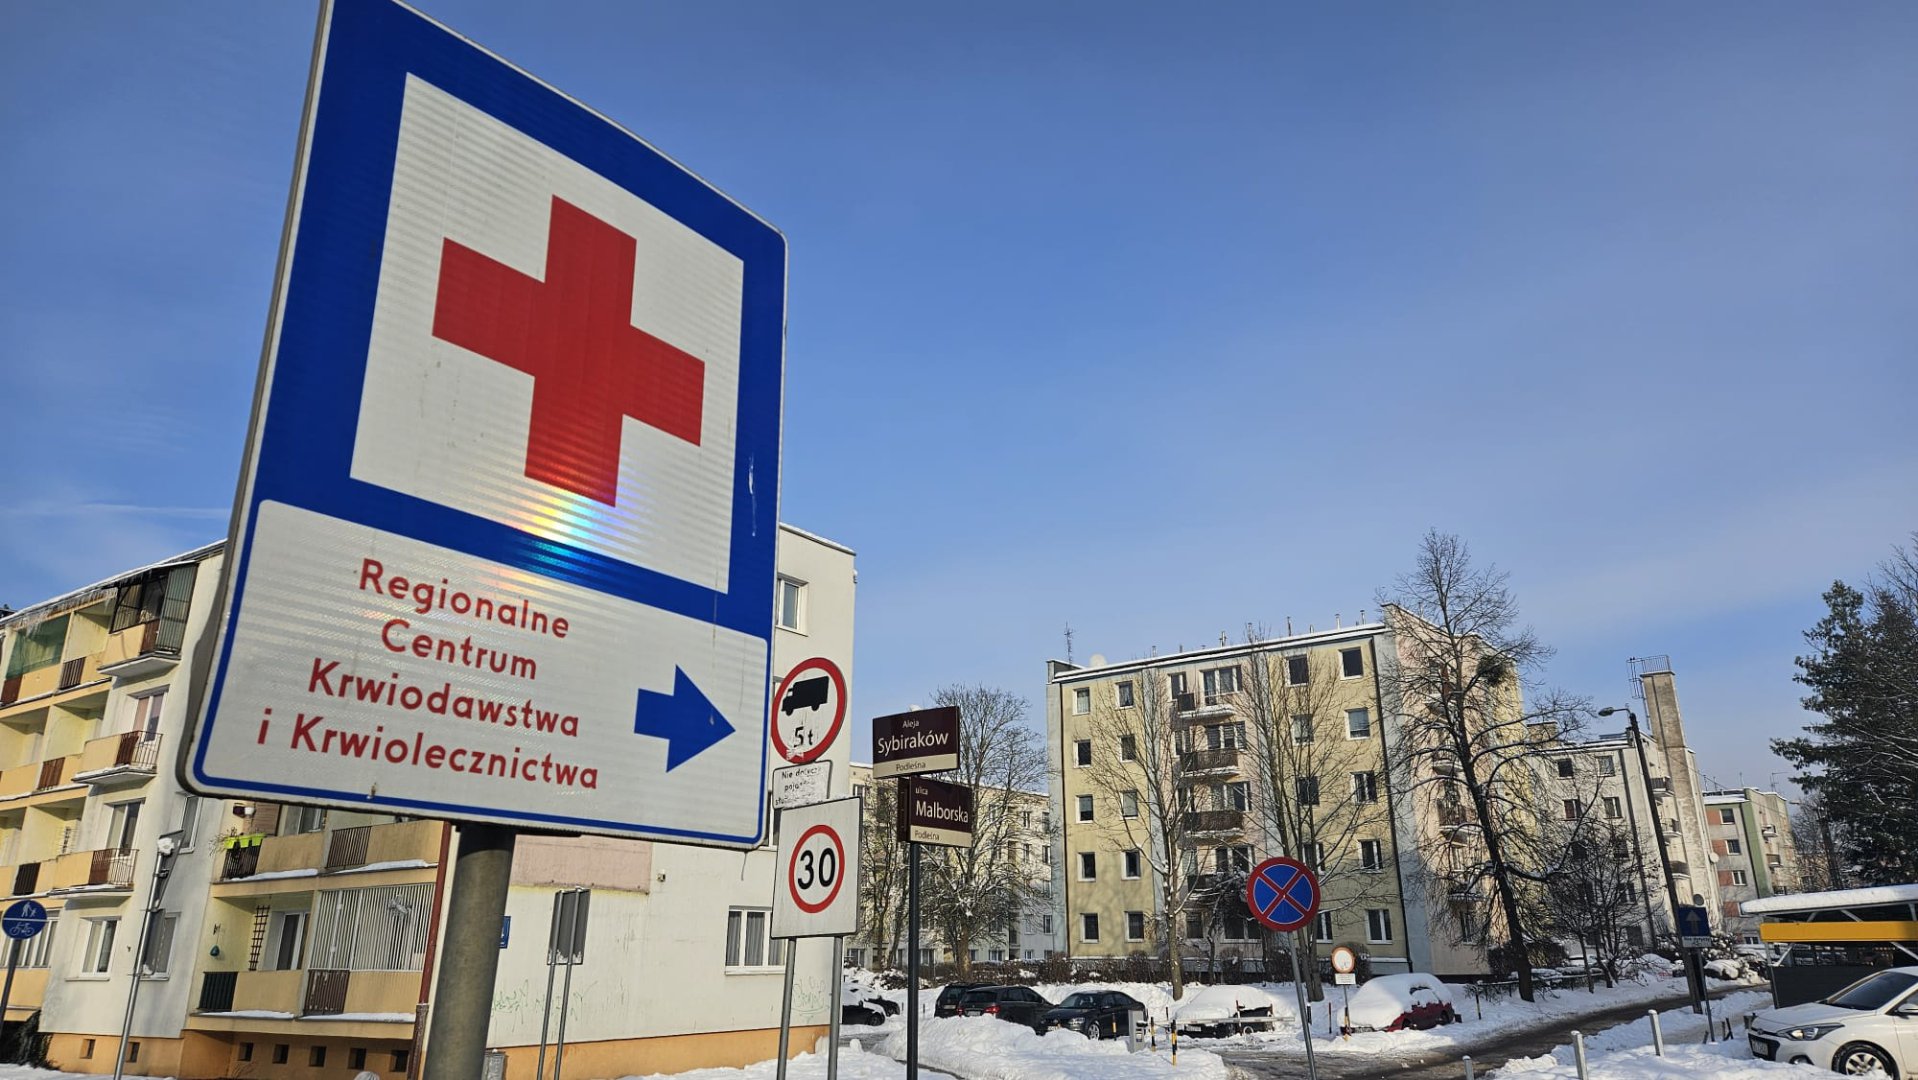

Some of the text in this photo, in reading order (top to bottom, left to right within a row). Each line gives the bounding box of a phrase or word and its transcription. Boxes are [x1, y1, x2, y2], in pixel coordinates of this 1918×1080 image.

[360, 559, 569, 638] Regionalne
[381, 618, 537, 680] Centrum
[308, 658, 579, 737] Krwiodawstwa
[902, 719, 920, 729] Aleja
[258, 709, 598, 789] i Krwiolecznictwa
[877, 730, 949, 757] Sybiraków
[782, 770, 794, 779] Nie
[895, 761, 926, 772] Podleśna
[915, 786, 929, 795] ulica
[915, 800, 969, 823] Malborska
[797, 847, 836, 890] 30
